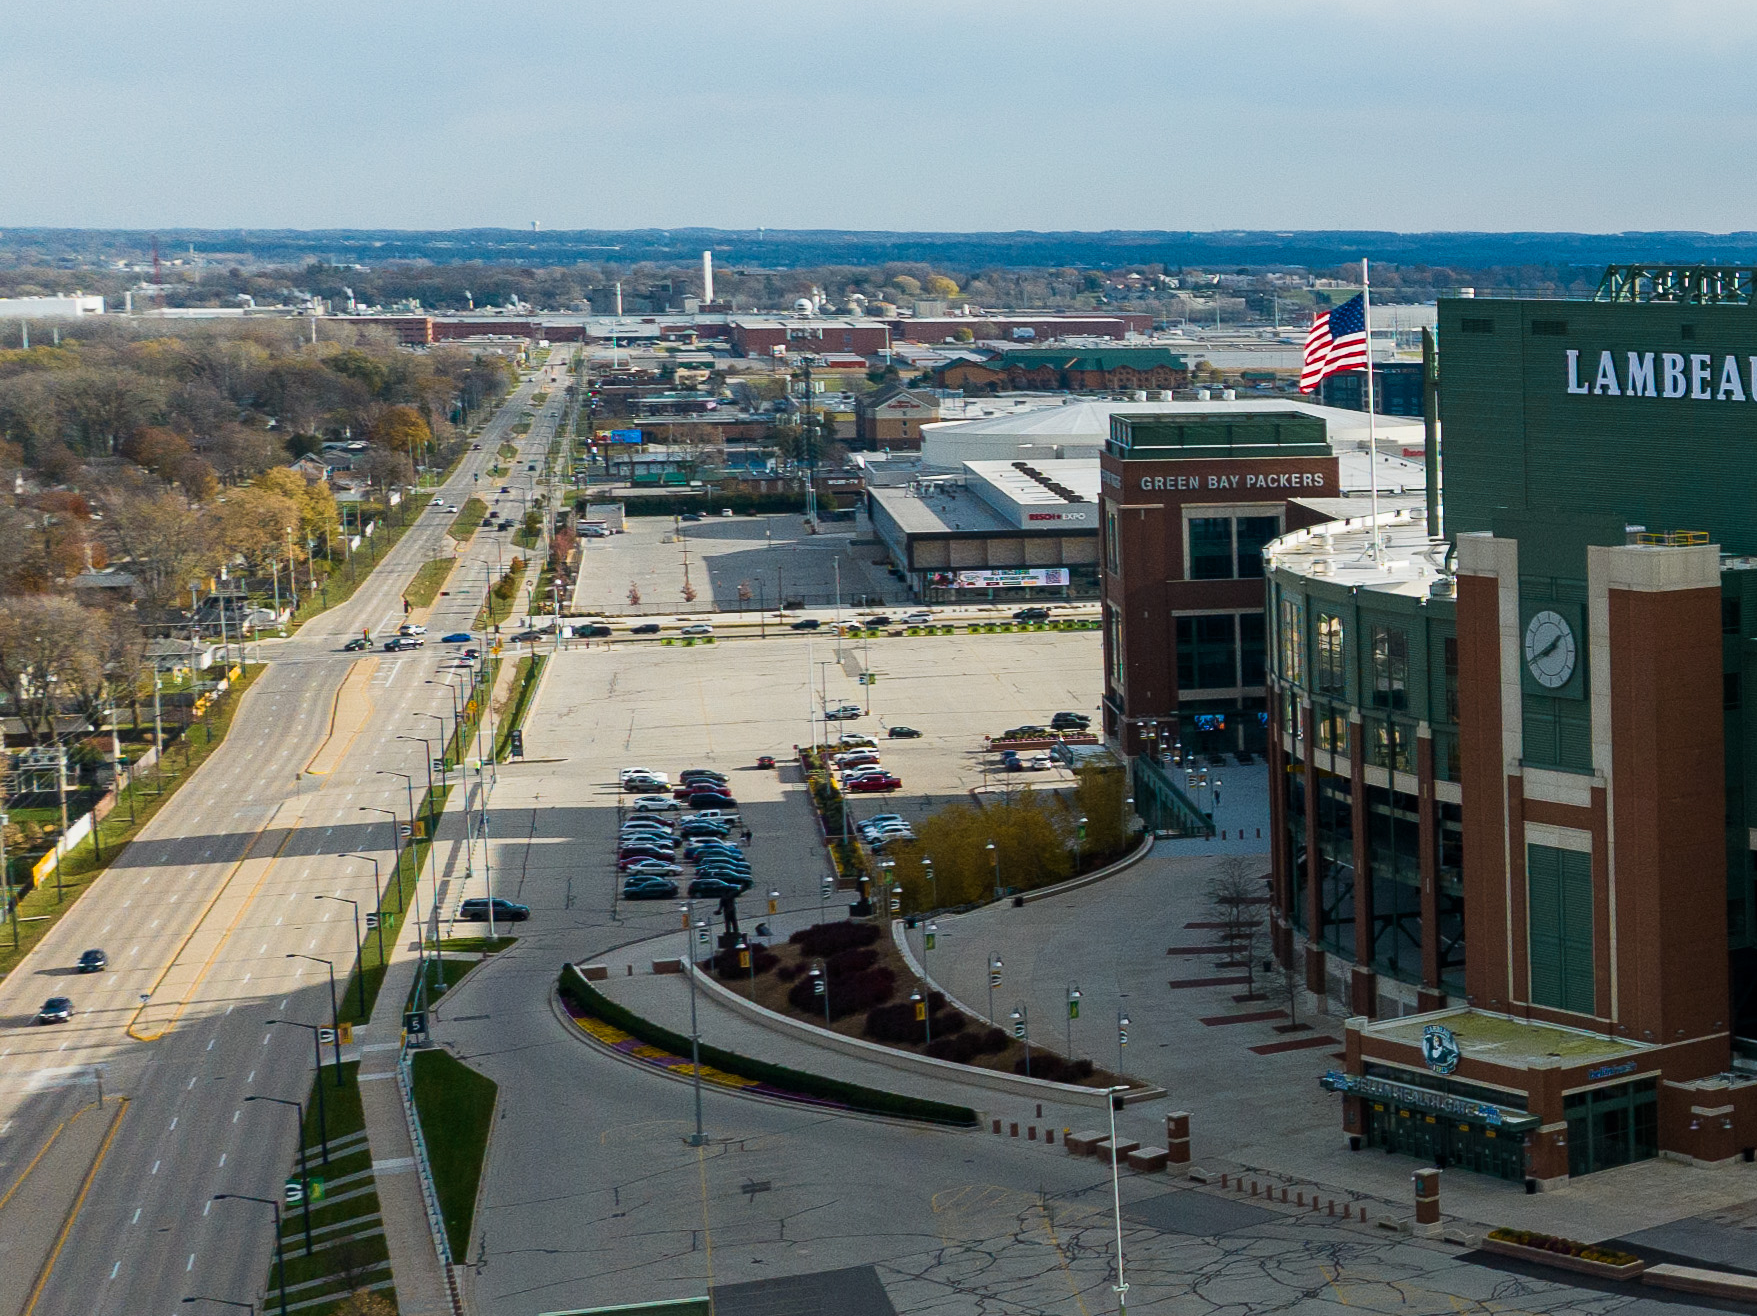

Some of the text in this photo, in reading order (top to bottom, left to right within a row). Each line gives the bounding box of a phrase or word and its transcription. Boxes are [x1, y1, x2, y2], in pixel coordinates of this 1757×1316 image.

[1141, 476, 1199, 491] GREEN
[1208, 474, 1240, 490] BAY
[1246, 472, 1325, 488] PACKERS
[1062, 512, 1086, 520] EXPO
